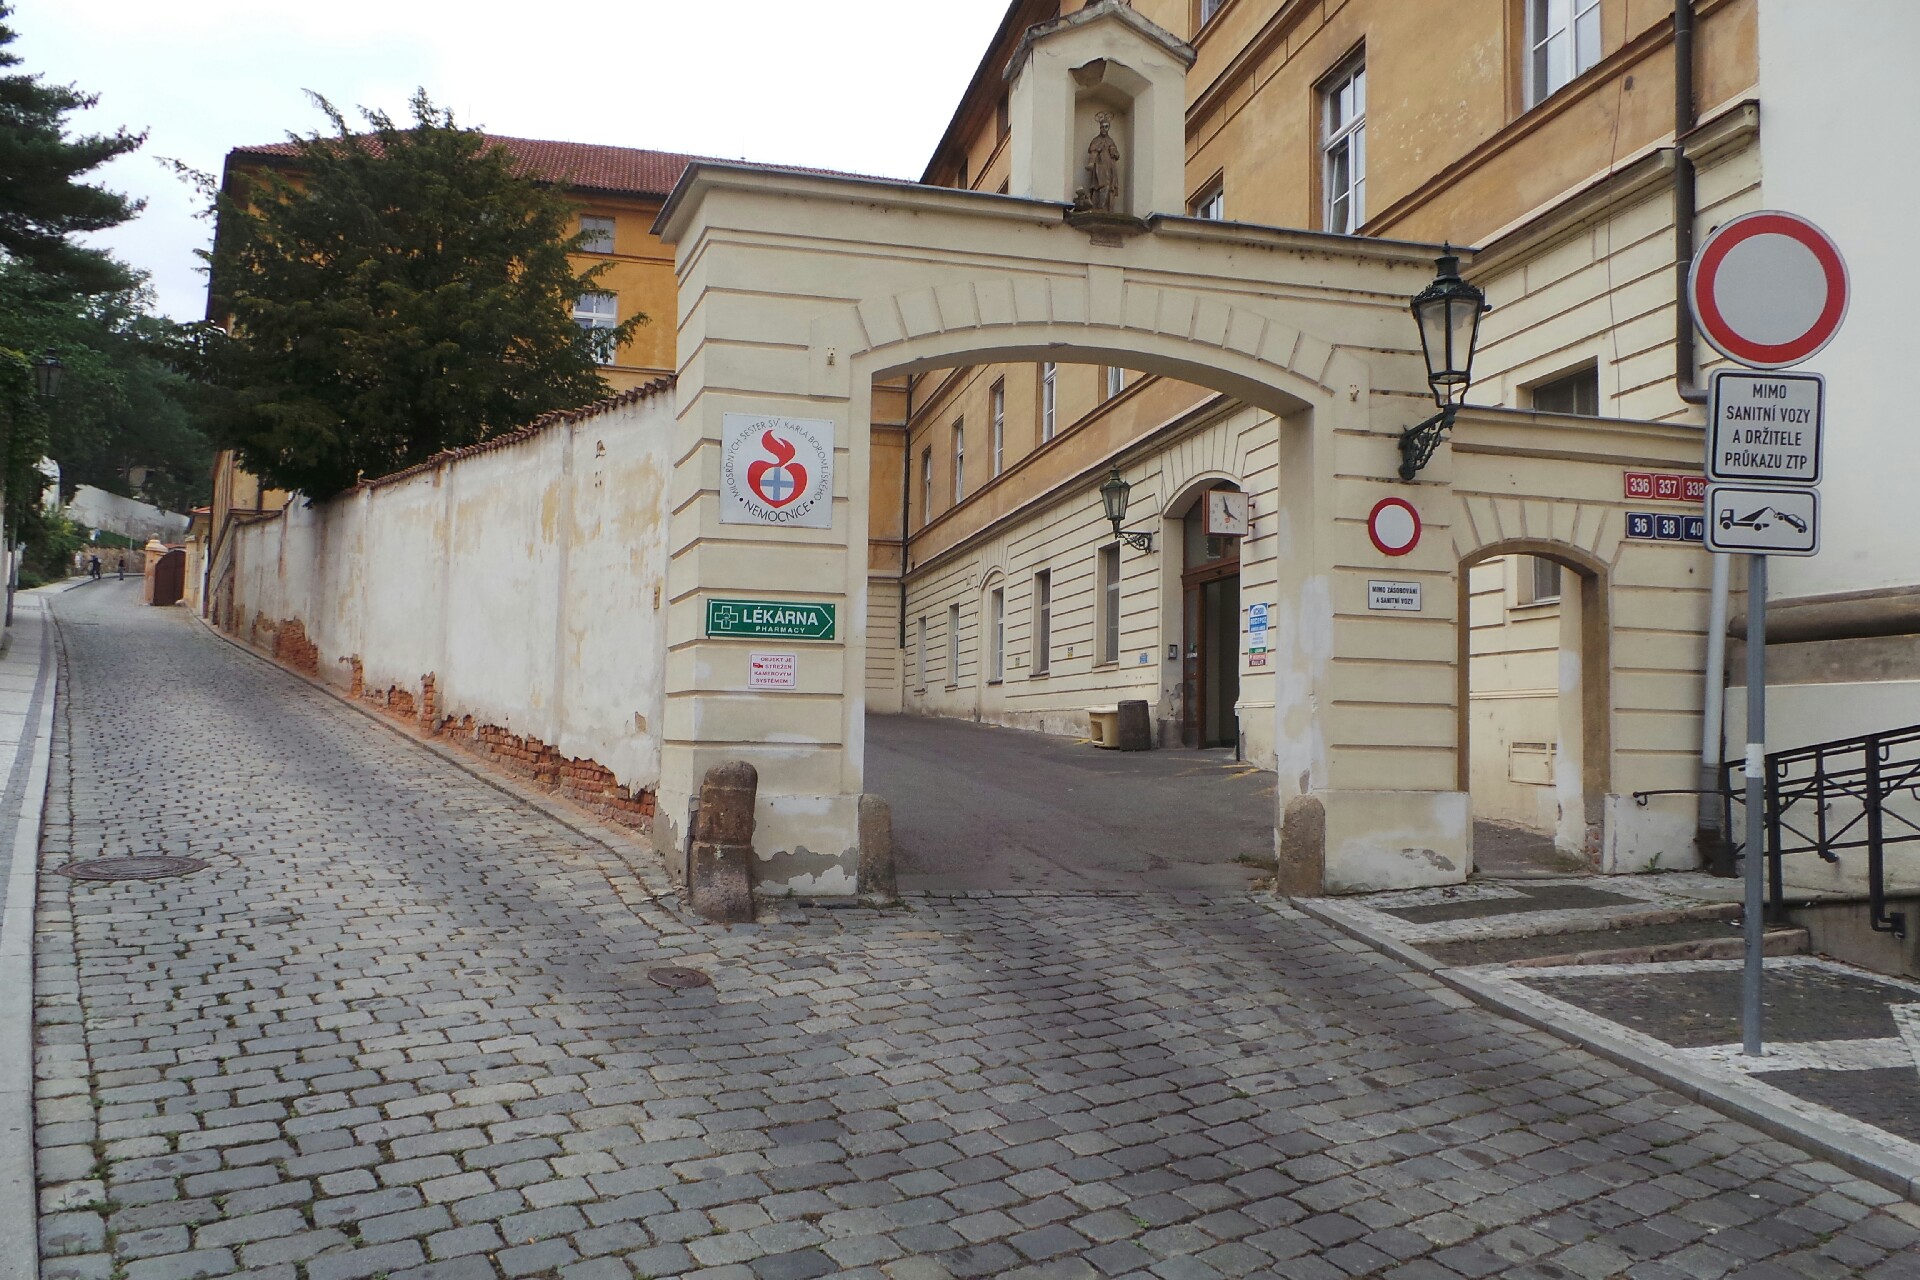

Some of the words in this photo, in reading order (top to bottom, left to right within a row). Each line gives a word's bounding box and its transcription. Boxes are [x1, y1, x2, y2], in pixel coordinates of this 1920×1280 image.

[1752, 383, 1787, 399] MIMO
[1726, 405, 1777, 421] SANITNÍ
[1780, 408, 1811, 424] VOZY
[740, 421, 766, 440] SESTER
[784, 421, 808, 439] KARLA
[1733, 429, 1741, 444] A
[1745, 427, 1802, 447] DRŽITELE
[1725, 449, 1782, 468] PRŮKAZU
[1786, 454, 1808, 470] ZTP
[1630, 477, 1650, 493] 336
[1658, 479, 1677, 494] 337
[1686, 481, 1705, 496] 338
[743, 500, 811, 523] NEMOCNICE
[1634, 518, 1648, 534] 36
[1662, 519, 1675, 534] 38
[1690, 522, 1703, 536] 40
[1380, 596, 1400, 604] SANITNÍ
[1387, 586, 1418, 595] ZÁSOBOVÁNÍ
[743, 607, 818, 625] LÉKÁRNA
